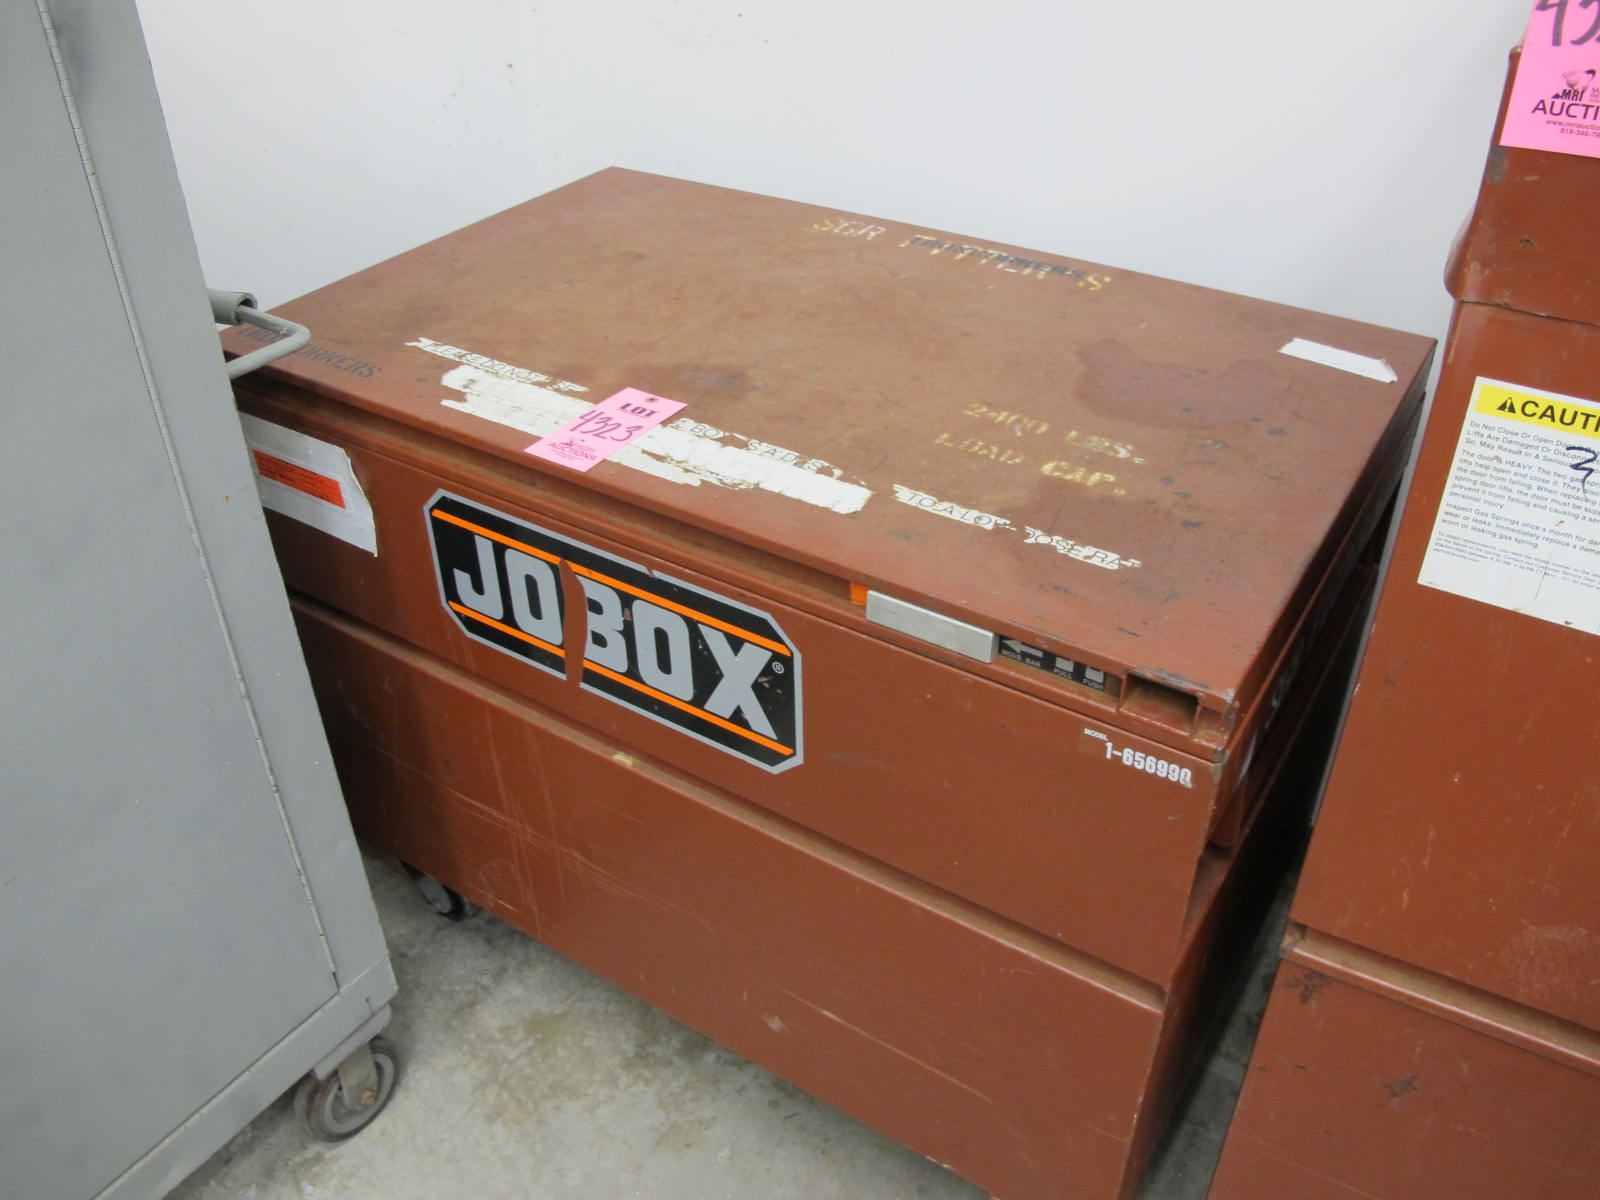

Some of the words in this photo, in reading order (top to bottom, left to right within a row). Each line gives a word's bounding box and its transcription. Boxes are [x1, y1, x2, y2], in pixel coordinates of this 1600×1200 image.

[1560, 87, 1587, 101] MRI
[619, 402, 660, 417] LOT
[570, 409, 643, 442] 4323
[1469, 420, 1480, 428] Do
[1481, 423, 1495, 431] Not
[1497, 426, 1519, 437] Close
[1532, 434, 1553, 444] Open
[1466, 429, 1484, 438] Lifts
[1485, 433, 1499, 442] Are
[1501, 436, 1539, 450] Damaged
[1541, 445, 1551, 453] Or
[1479, 440, 1494, 449] May
[1496, 444, 1522, 456] Result
[1461, 449, 1475, 457] The
[1537, 466, 1551, 475] The
[1553, 470, 1567, 479] two
[1455, 466, 1468, 474] the
[1468, 469, 1486, 479] door
[1488, 474, 1506, 484] from
[1535, 485, 1558, 496] When
[1560, 491, 1596, 505] replacing
[1473, 461, 1490, 470] help
[1491, 465, 1511, 475] open
[1512, 470, 1528, 479] and
[1529, 474, 1550, 485] close
[1562, 481, 1580, 492] They
[1448, 490, 1481, 503] personal
[1450, 482, 1479, 494] prevent
[1487, 491, 1505, 501] from
[1506, 495, 1530, 507] falling
[1532, 501, 1546, 511] and
[1548, 505, 1579, 519] causing
[1453, 474, 1477, 485] spring
[1478, 480, 1496, 489] door
[1516, 489, 1528, 497] the
[1531, 492, 1548, 502] door
[1550, 497, 1569, 507] must
[1440, 517, 1460, 528] worn
[1470, 525, 1497, 537] leaking
[1497, 532, 1513, 541] gas
[1445, 502, 1473, 514] Inspect
[1473, 509, 1488, 518] Gas
[1489, 513, 1519, 526] Springs
[1521, 521, 1539, 531] once
[1548, 527, 1573, 539] month
[1575, 534, 1585, 543] for
[1494, 523, 1539, 540] Immediately
[1542, 535, 1570, 548] replace
[453, 531, 777, 740] JOBOX
[1001, 649, 1023, 662] MOVE
[1024, 656, 1042, 668] BAR
[1052, 667, 1073, 681] PULL
[1081, 677, 1104, 691] PUSH
[1083, 728, 1109, 741] MODEL
